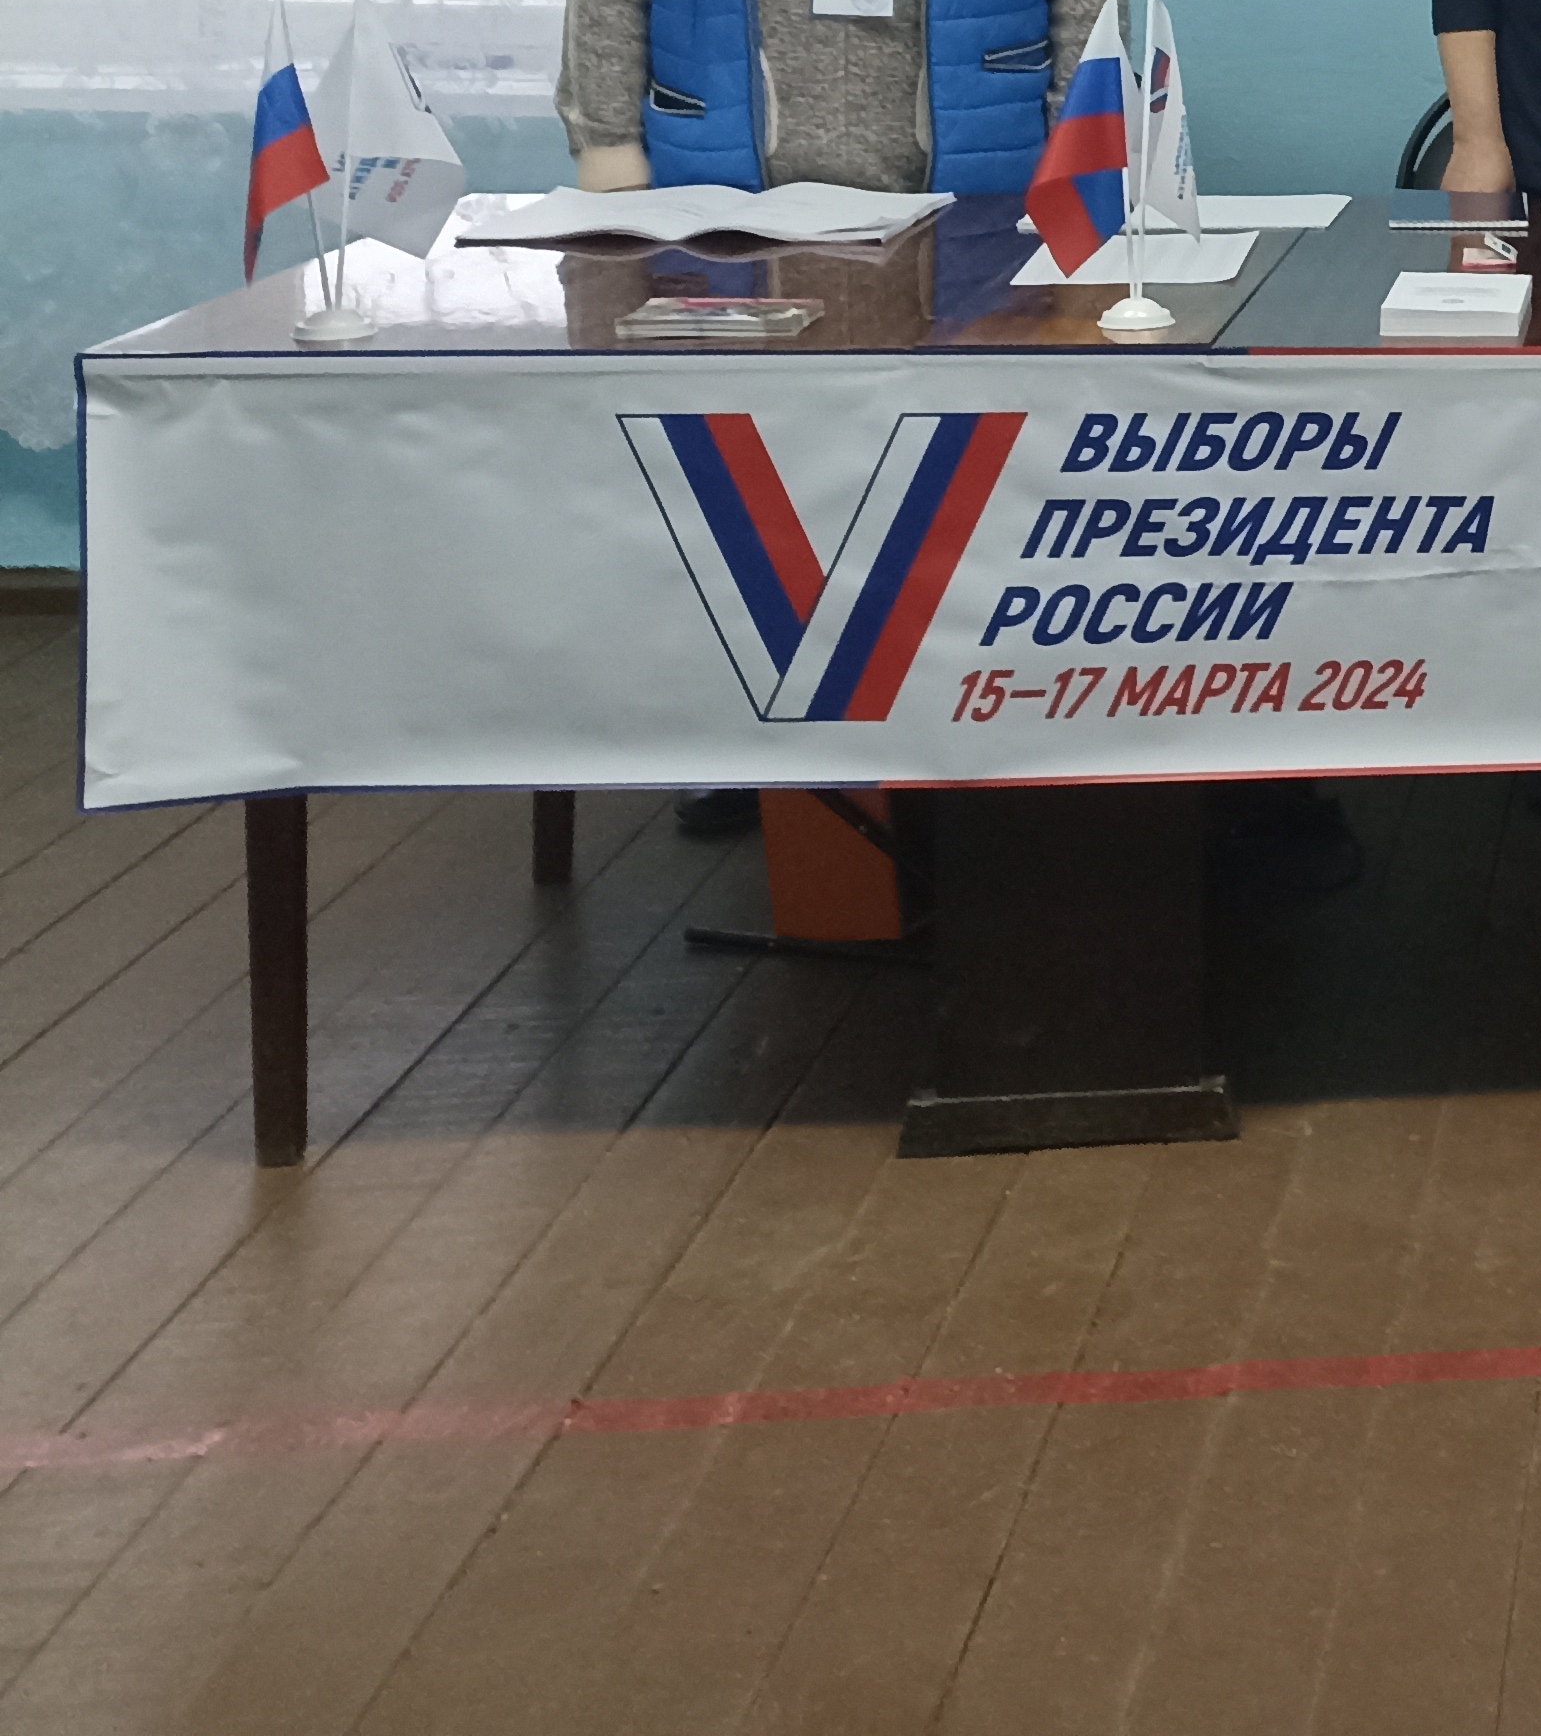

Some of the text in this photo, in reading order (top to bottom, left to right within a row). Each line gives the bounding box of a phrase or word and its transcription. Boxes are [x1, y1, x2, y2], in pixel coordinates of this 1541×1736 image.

[1059, 410, 1403, 474] ВЫБОРЫ
[1019, 495, 1496, 567] ПРЕЗИДЕНТА
[978, 581, 1295, 647] РОССИИ
[1105, 662, 1292, 718] МАРТА
[1297, 658, 1429, 713] 2024
